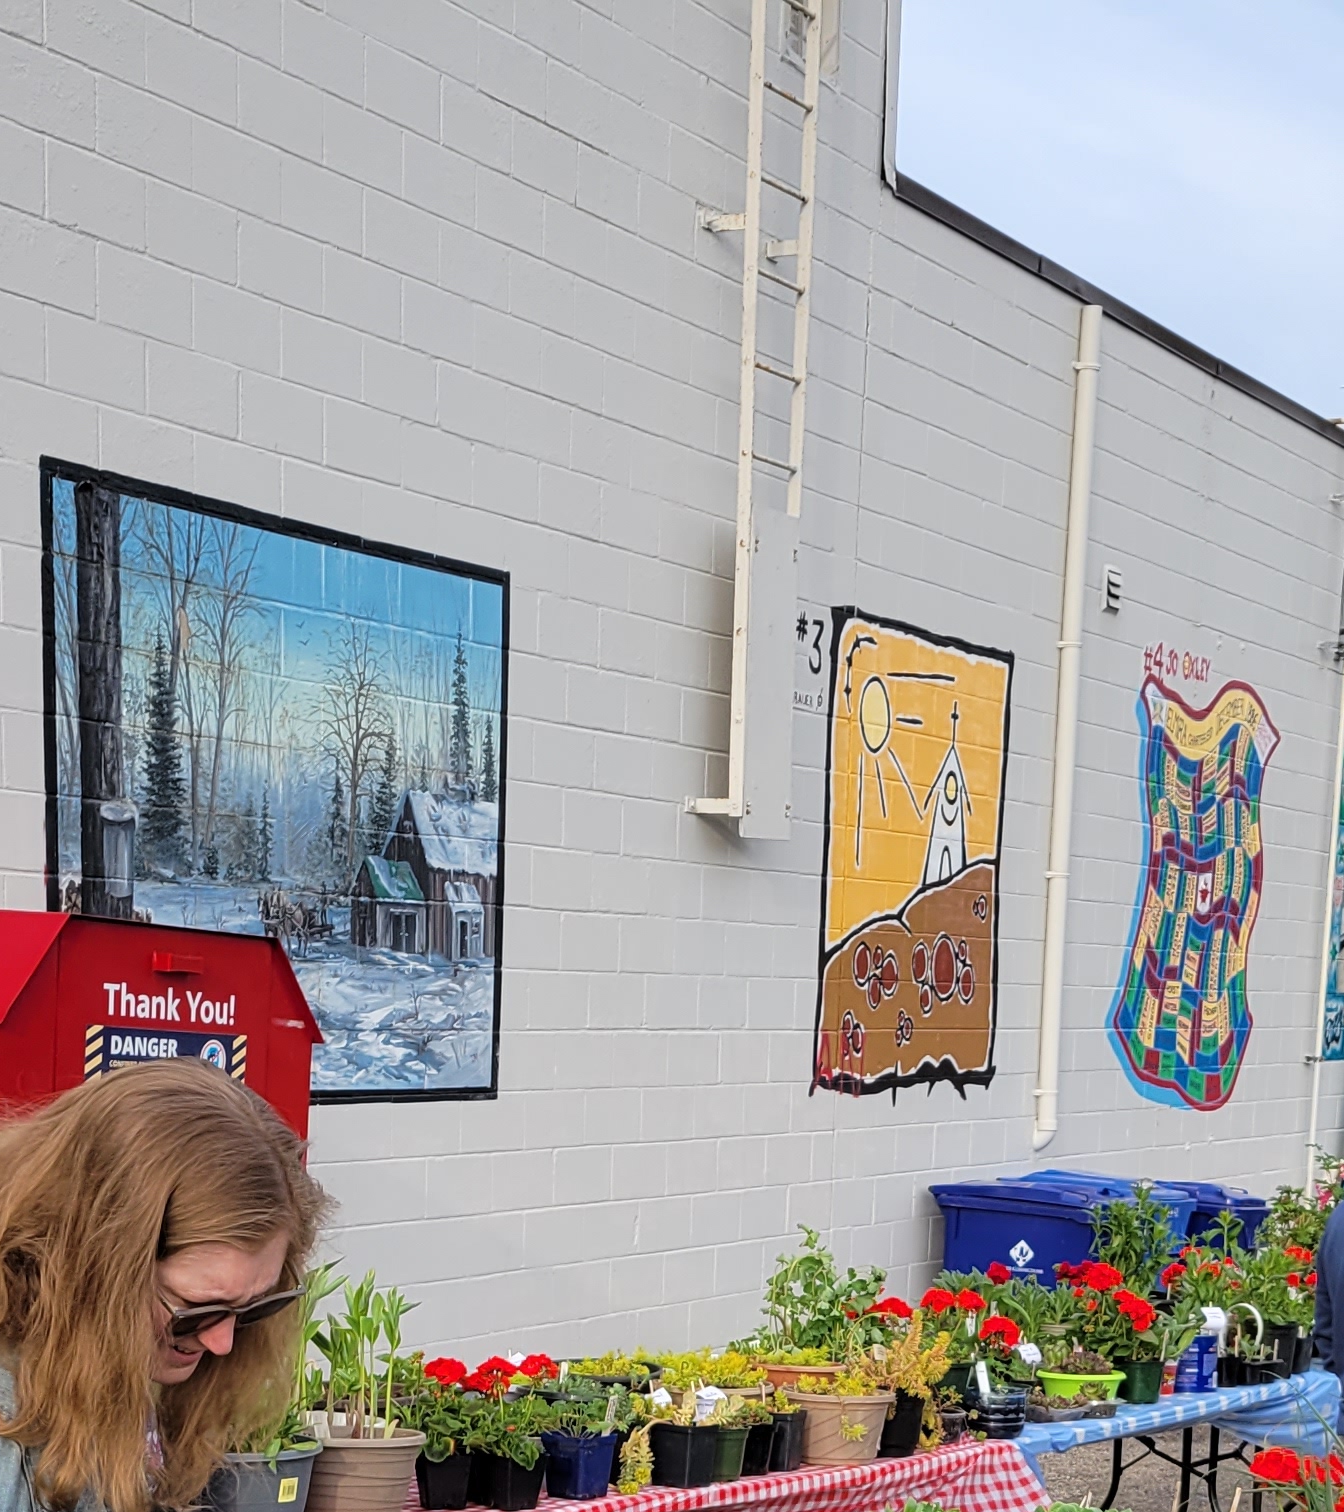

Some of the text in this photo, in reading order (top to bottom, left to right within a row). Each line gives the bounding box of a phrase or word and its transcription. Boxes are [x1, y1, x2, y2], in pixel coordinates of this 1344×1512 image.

[796, 611, 824, 675] #3
[1144, 642, 1164, 684] #4
[1183, 651, 1210, 682] OXLEY
[103, 982, 235, 1026] Thank You!
[110, 1035, 178, 1058] DANGER
